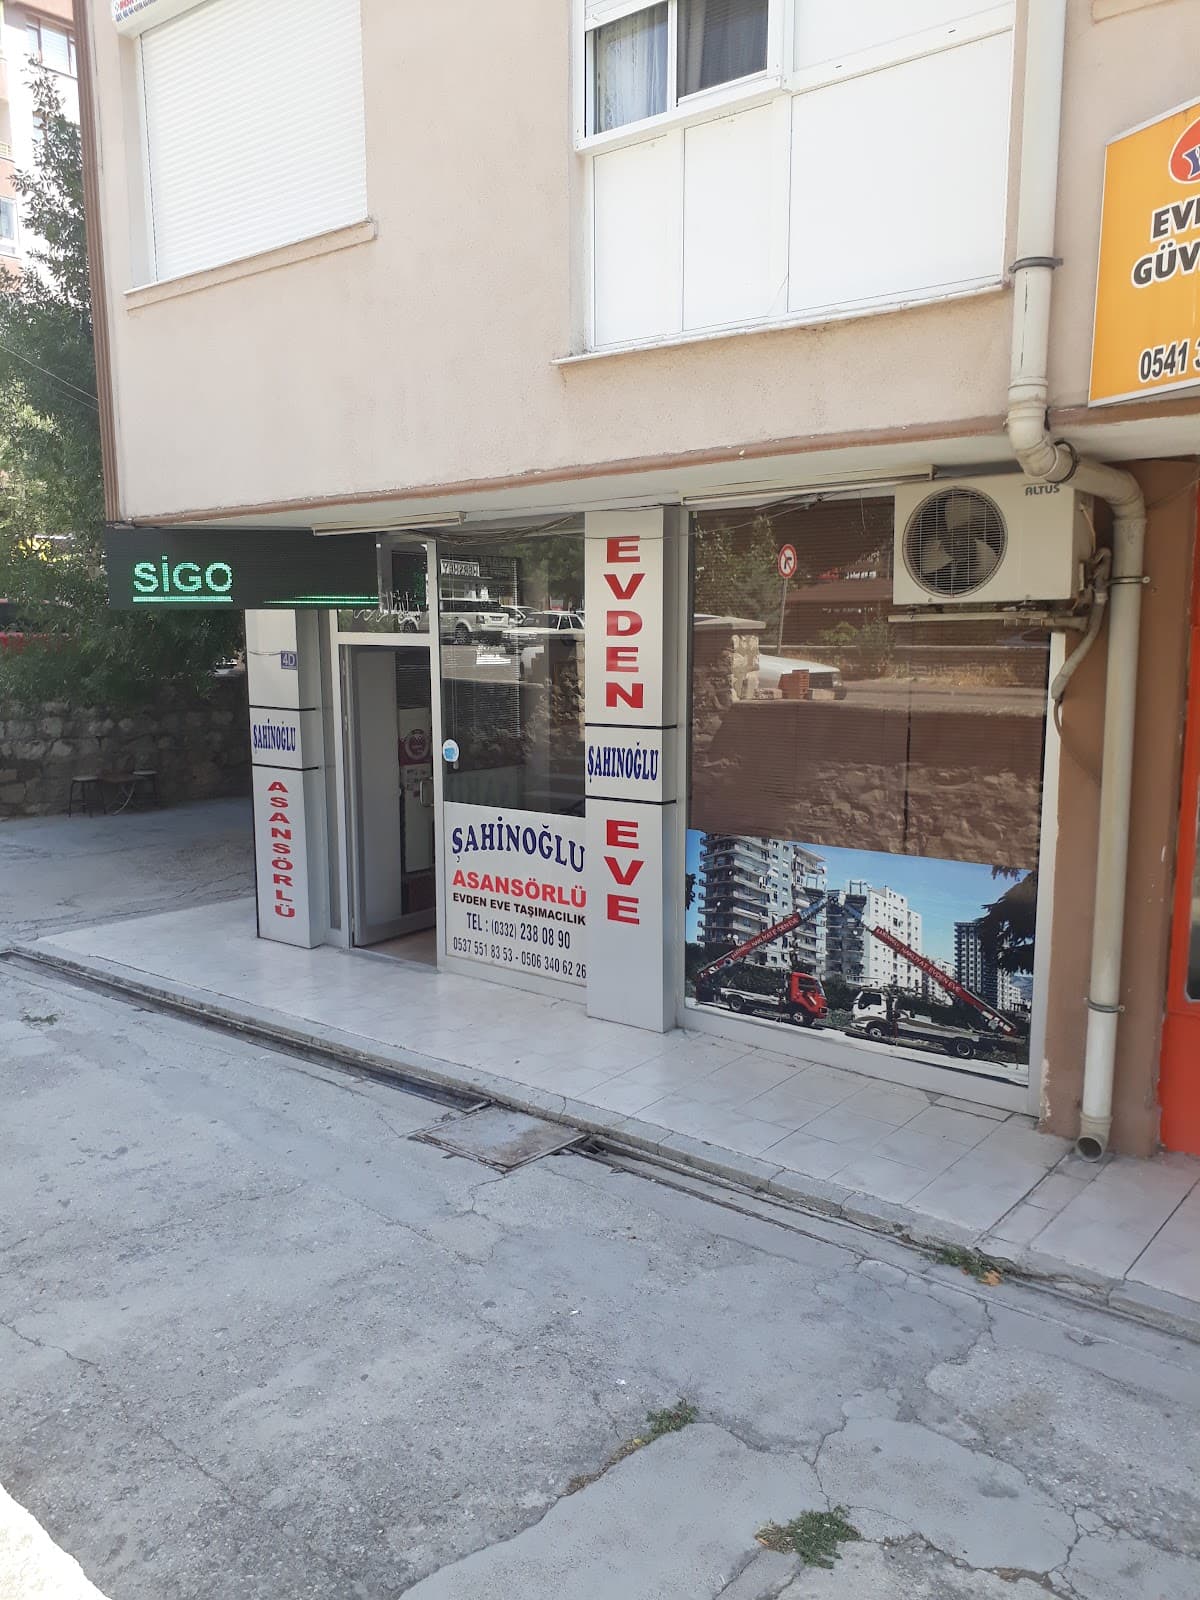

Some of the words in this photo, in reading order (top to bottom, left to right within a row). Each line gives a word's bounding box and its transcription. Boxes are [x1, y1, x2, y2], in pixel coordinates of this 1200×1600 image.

[1140, 341, 1188, 380] 0541
[1025, 484, 1060, 496] ALTUS
[603, 535, 646, 709] EVDEN
[282, 653, 296, 667] 4D
[267, 781, 295, 918] ASANSÖRLÜ
[452, 816, 586, 873] ŞAHİNOĞLU
[453, 869, 587, 908] ASANSÖRLÜ
[603, 819, 645, 925] EVE
[453, 892, 487, 908] EVDEN
[490, 899, 511, 912] EVE
[514, 903, 586, 926] TAŞIMACILIK
[491, 919, 517, 940] (0332)
[520, 922, 538, 943] 238
[542, 927, 554, 946] 08
[558, 930, 571, 950] 90
[453, 936, 471, 953] 0537
[474, 940, 488, 957] 551
[491, 944, 501, 960] 83
[502, 946, 513, 962] 53
[521, 951, 542, 969] 0506
[544, 956, 560, 973] 340
[562, 959, 573, 976] 62
[576, 962, 587, 979] 26
